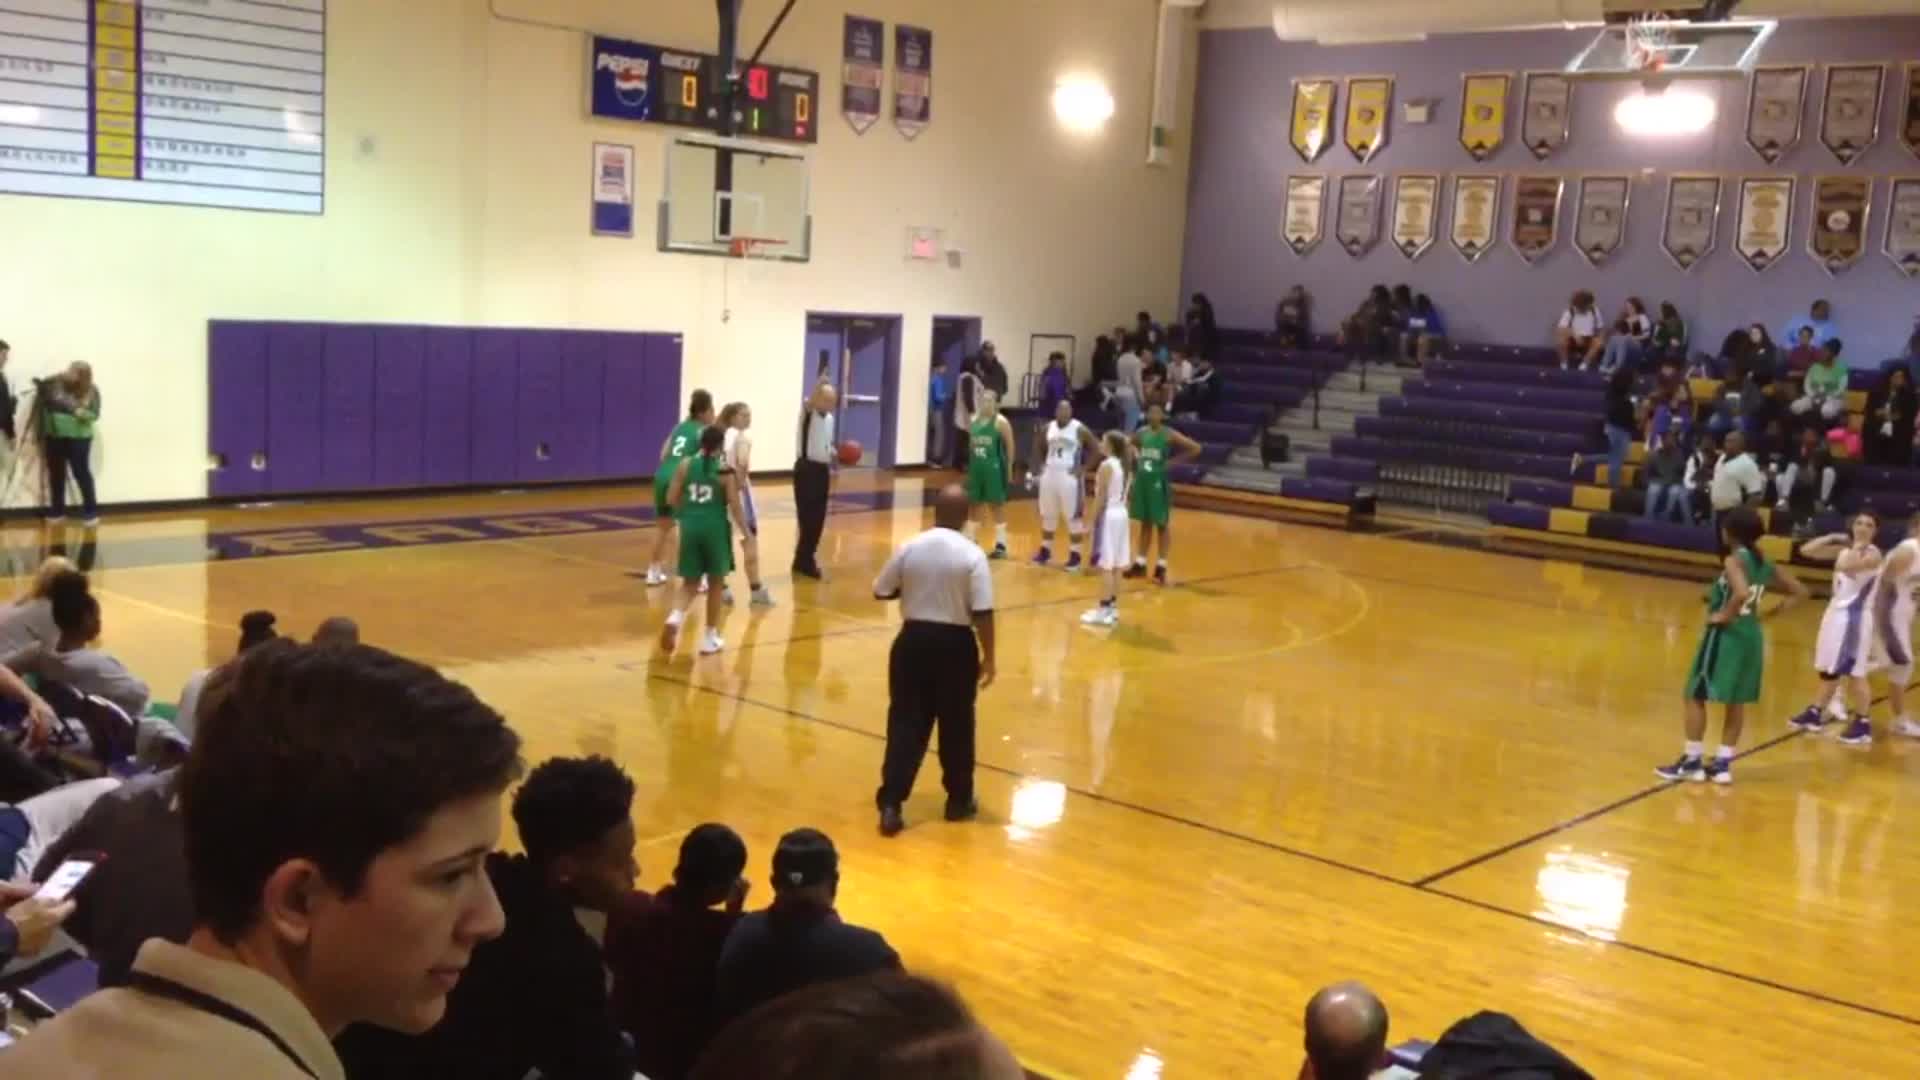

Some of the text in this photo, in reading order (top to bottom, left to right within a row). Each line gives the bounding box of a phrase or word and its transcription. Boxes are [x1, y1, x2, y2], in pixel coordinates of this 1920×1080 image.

[597, 53, 648, 76] PEPSI
[682, 75, 697, 107] 0
[796, 94, 809, 122] 0
[672, 435, 686, 456] 2
